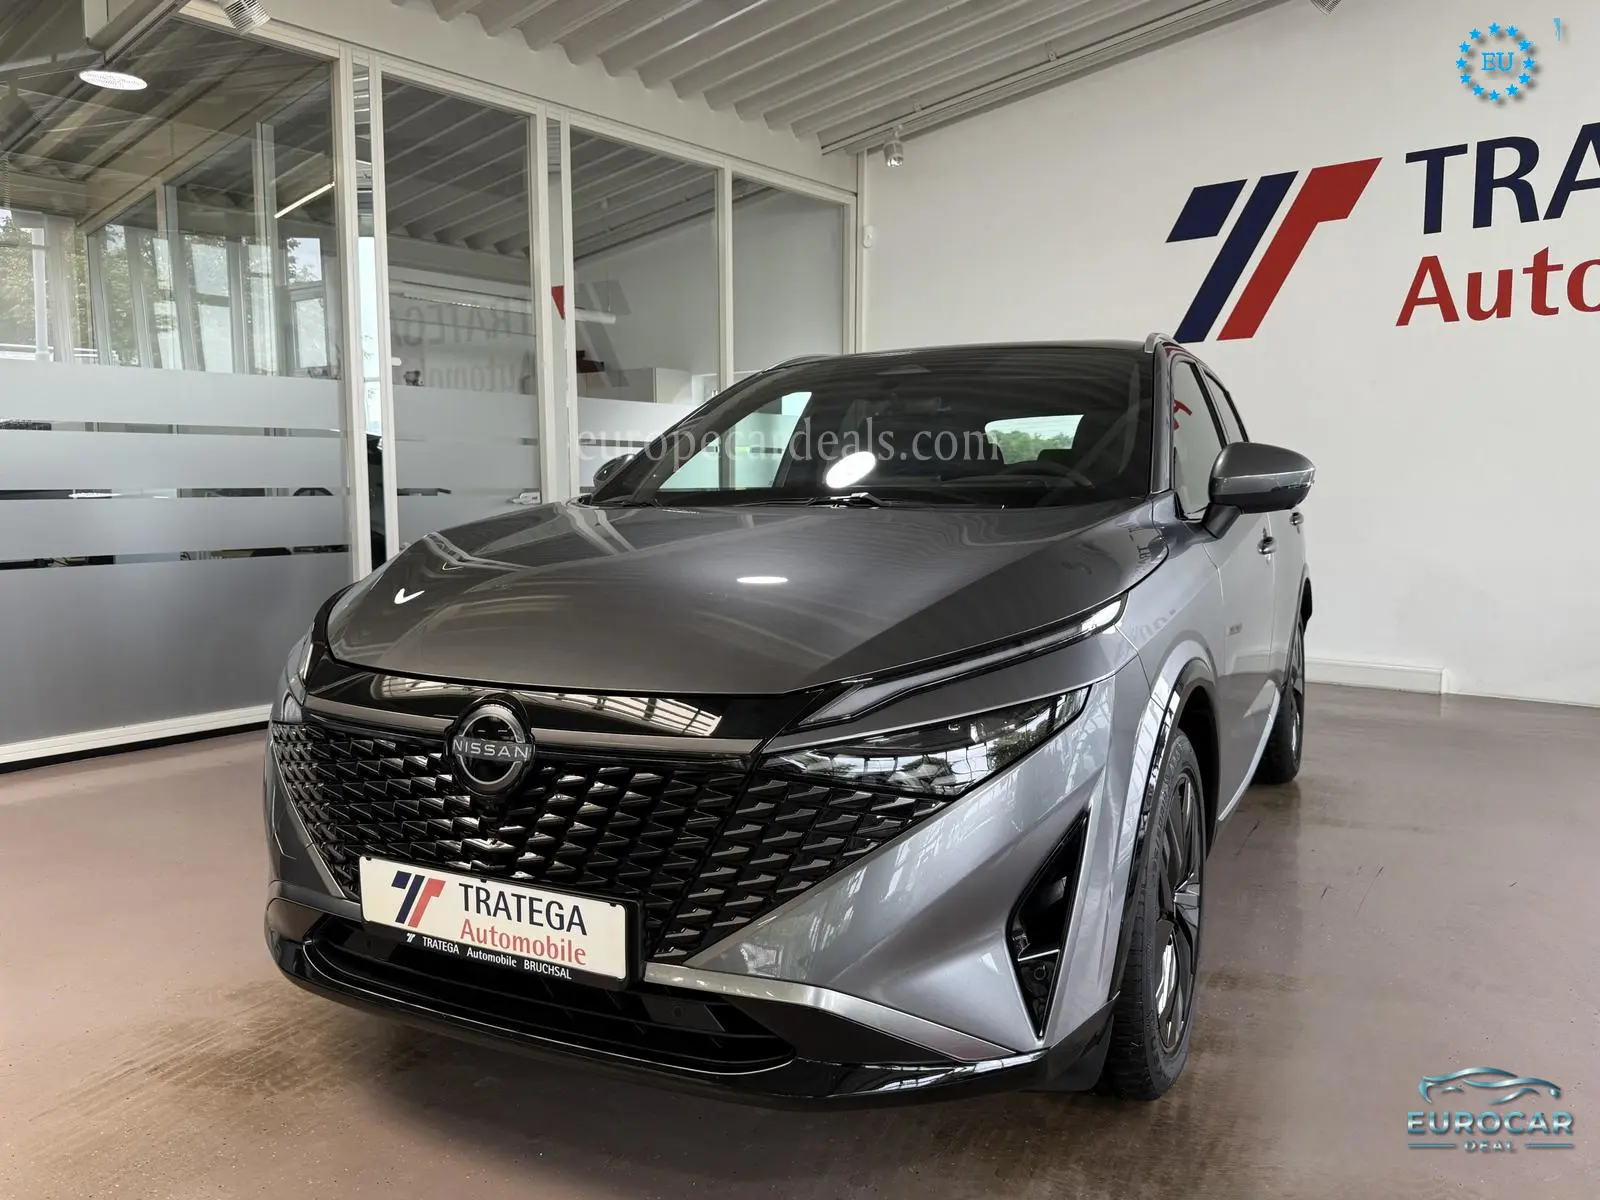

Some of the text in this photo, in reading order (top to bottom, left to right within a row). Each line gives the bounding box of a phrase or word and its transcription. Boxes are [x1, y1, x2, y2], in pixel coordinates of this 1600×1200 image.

[1395, 246, 1600, 327] Auto
[453, 739, 529, 759] NISSAN
[459, 883, 588, 936] TRATEGA
[422, 936, 572, 980] TRATEGA Automobile BRUCHSAL
[460, 919, 587, 966] Automobile
